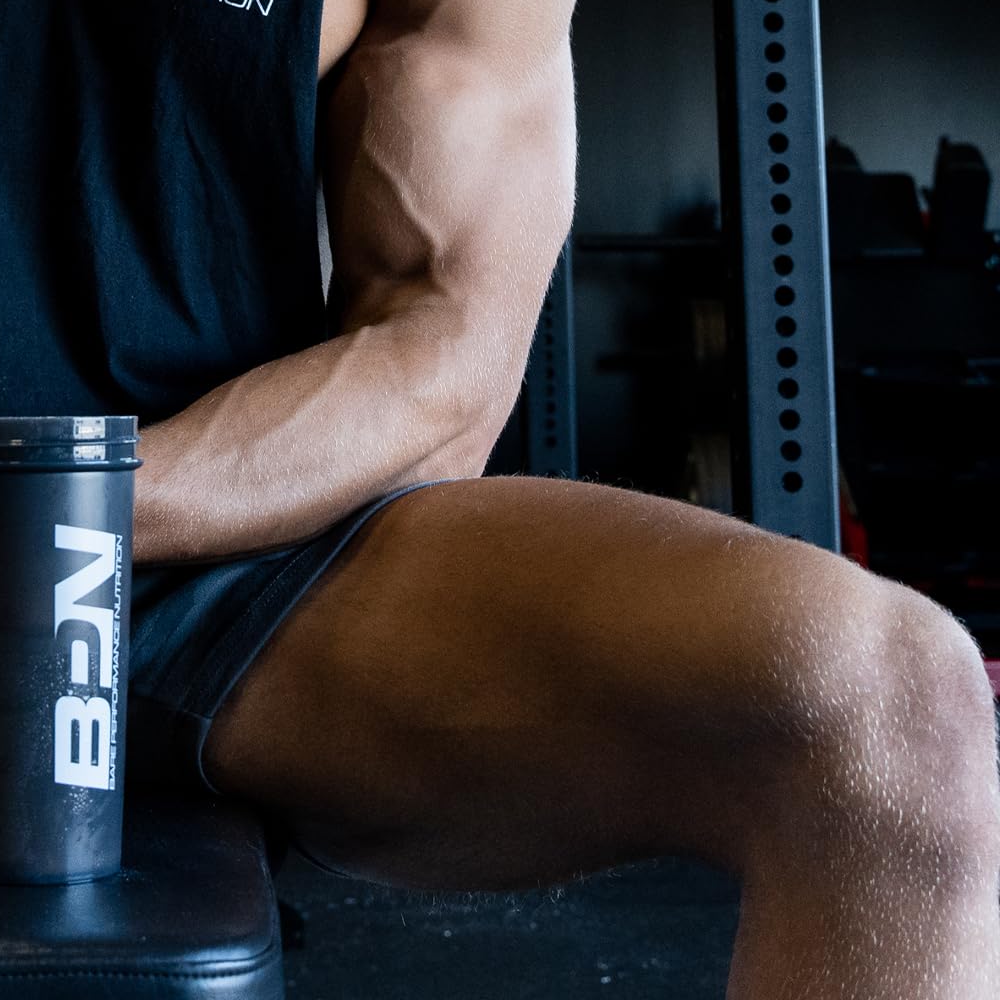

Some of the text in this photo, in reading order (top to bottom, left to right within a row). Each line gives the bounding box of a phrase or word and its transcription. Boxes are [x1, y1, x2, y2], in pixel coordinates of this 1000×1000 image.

[114, 534, 123, 619] NUTRITION
[54, 524, 116, 790] BPN
[110, 621, 120, 743] PERFORMANCE
